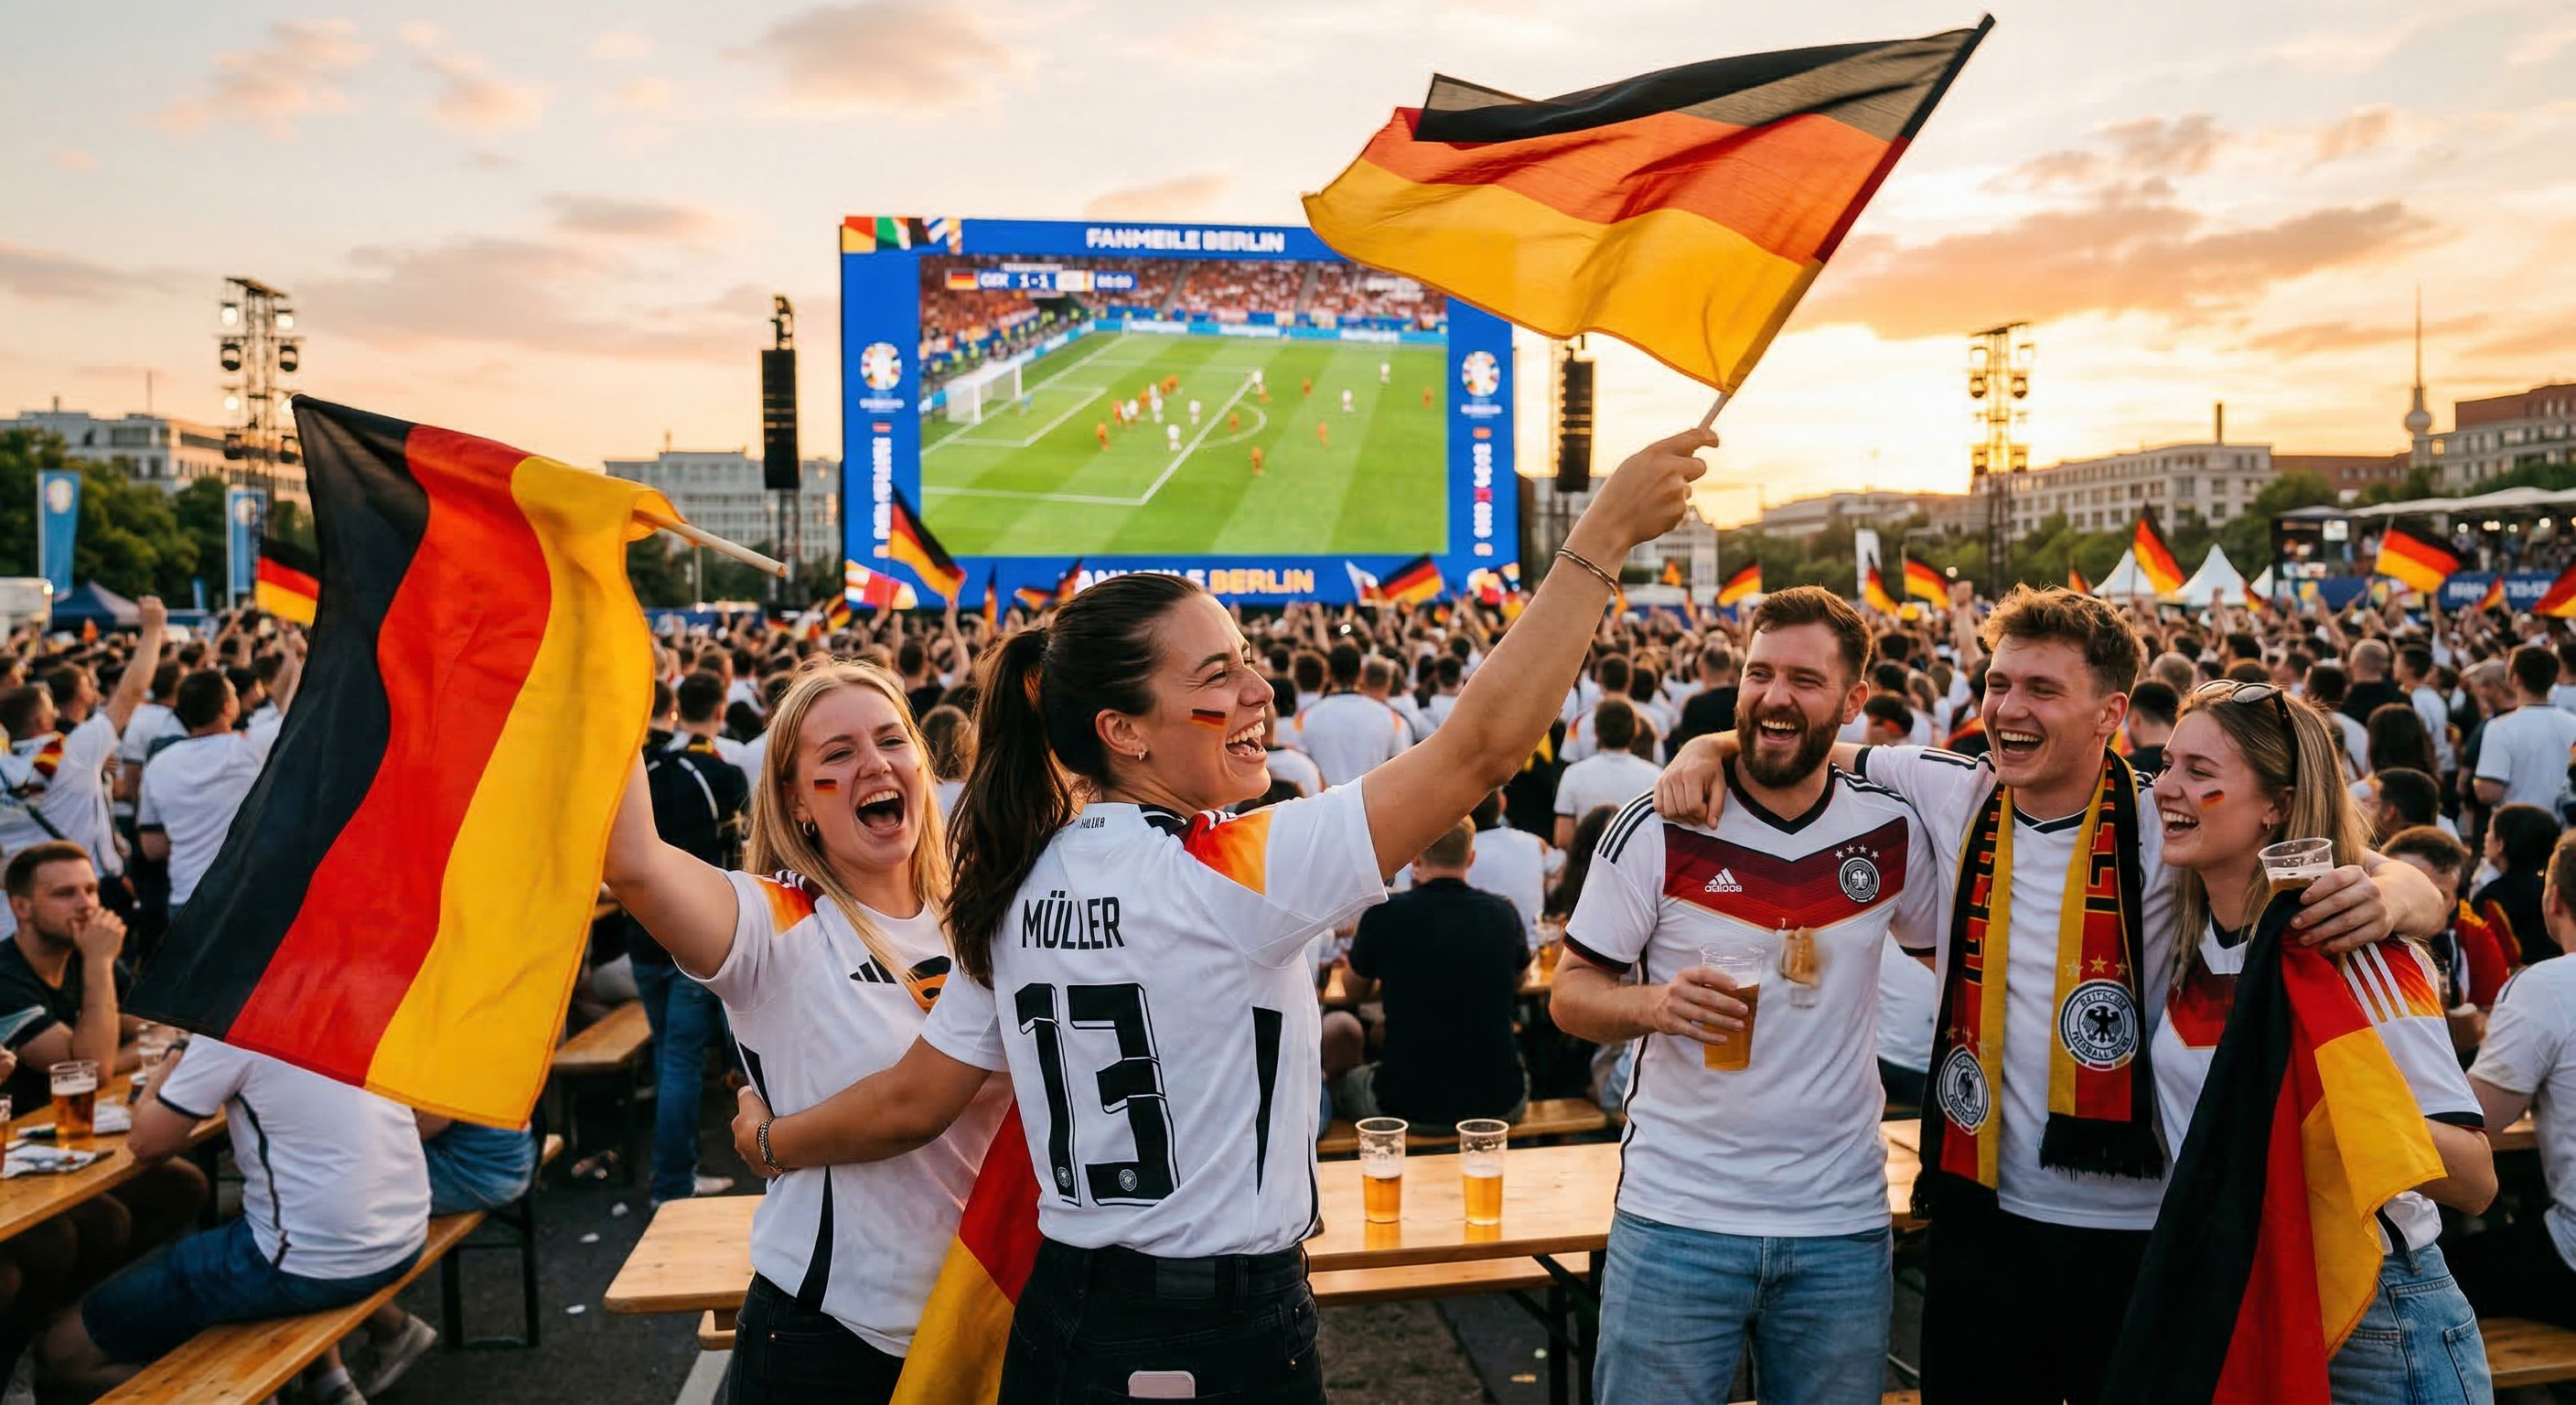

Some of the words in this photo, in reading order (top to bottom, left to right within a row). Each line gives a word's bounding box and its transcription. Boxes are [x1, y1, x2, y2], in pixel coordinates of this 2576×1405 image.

[1086, 227, 1200, 251] FANMEILE
[1202, 230, 1285, 252] BERLIN
[1208, 568, 1315, 595] BERLIN
[1021, 890, 1125, 950] MÜLLER
[1014, 982, 1180, 1207] 13
